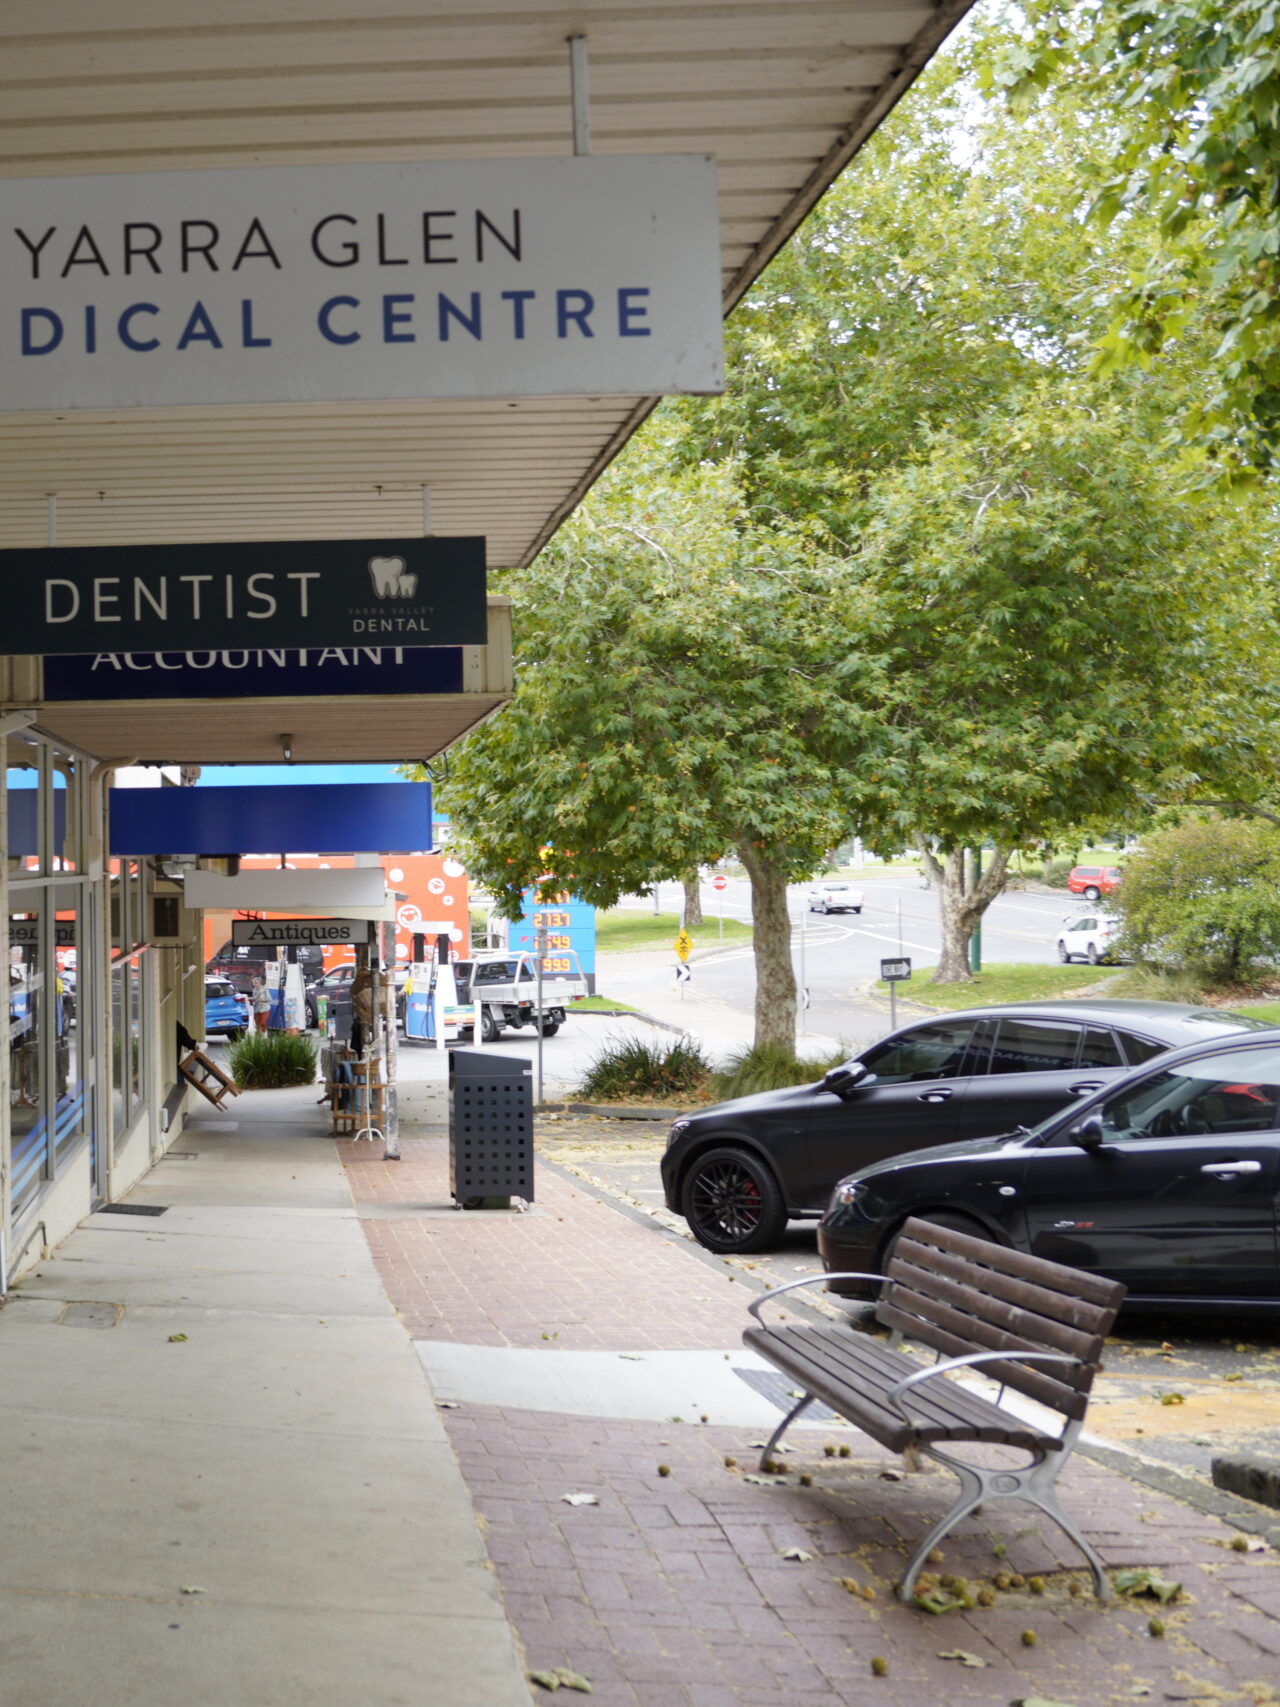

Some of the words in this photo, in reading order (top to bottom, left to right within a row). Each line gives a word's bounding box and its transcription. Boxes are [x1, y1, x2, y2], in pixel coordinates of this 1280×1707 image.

[14, 217, 281, 279] YARRA
[311, 208, 522, 268] GLEN
[317, 286, 652, 344] CENTRE
[45, 572, 321, 623] DENTIST
[353, 618, 430, 632] DENTAL
[91, 647, 404, 671] ACCOUNTANT
[533, 913, 570, 927] 213.7
[248, 924, 351, 945] Antiques
